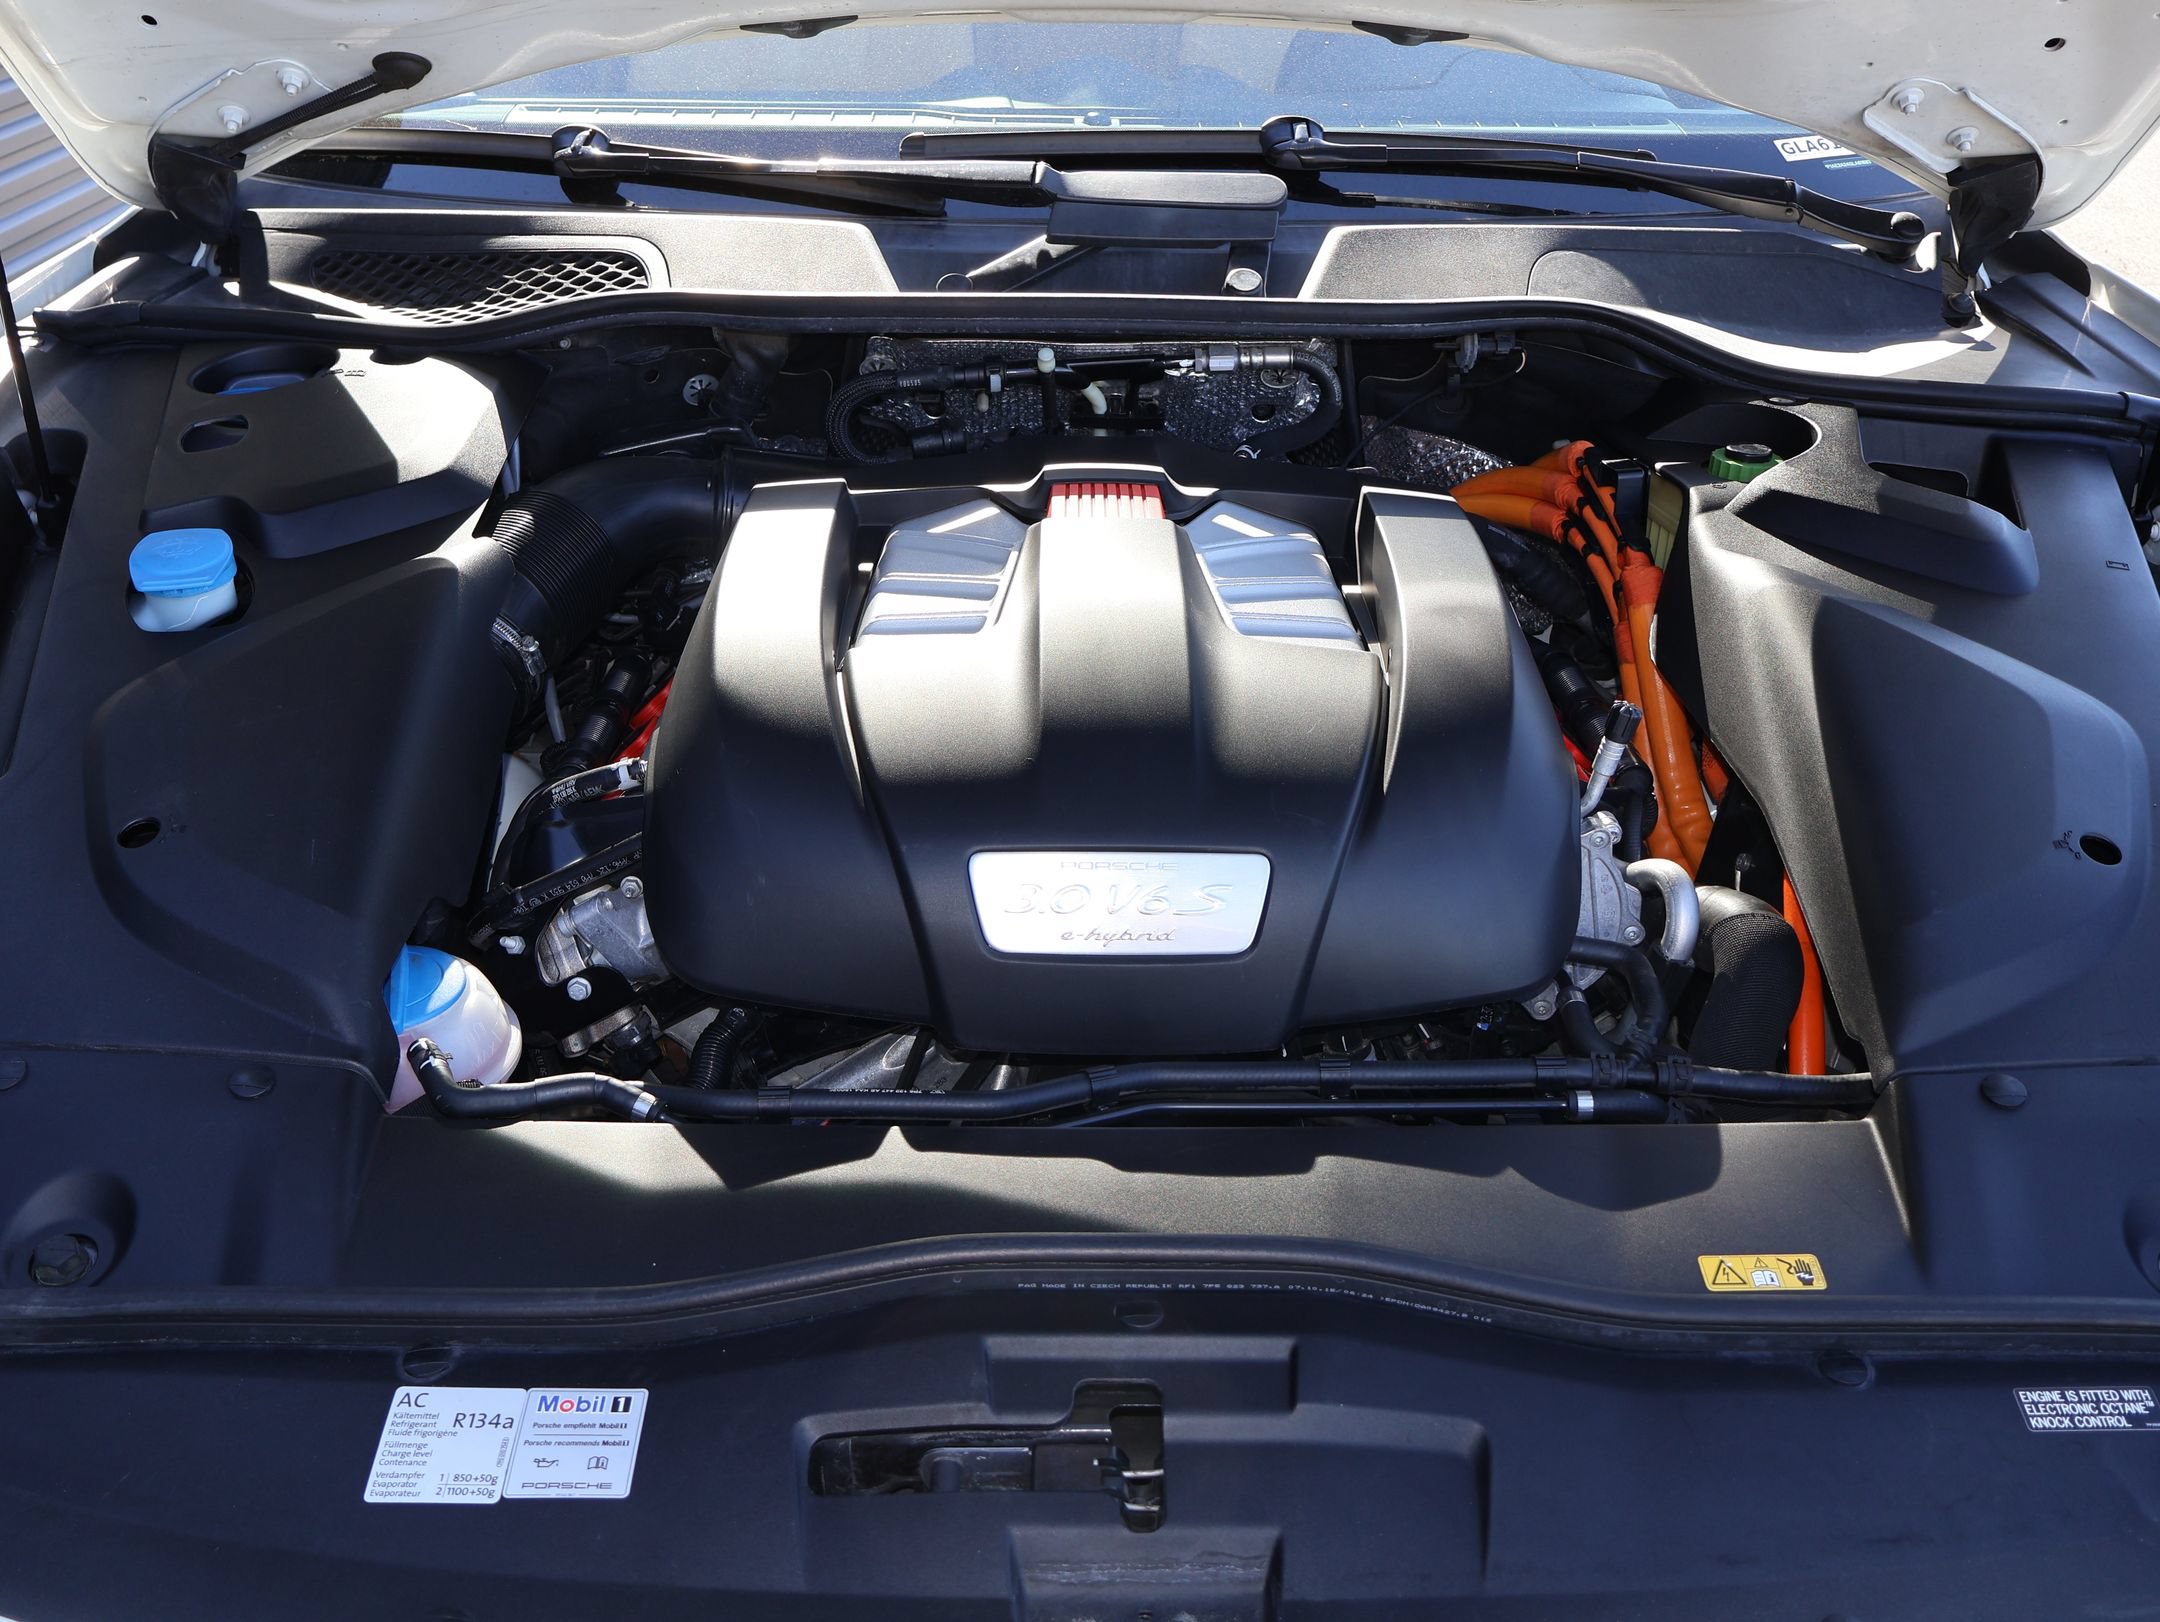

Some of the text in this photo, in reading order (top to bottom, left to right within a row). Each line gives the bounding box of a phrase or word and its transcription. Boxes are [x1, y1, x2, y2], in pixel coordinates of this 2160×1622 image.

[1060, 861, 1178, 871] PORSCHE
[1003, 884, 1233, 916] 3.0 V6 S
[1060, 928, 1176, 948] e-hybrid
[396, 1392, 430, 1408] AC
[2018, 1389, 2152, 1403] ENGINE IS FITTED WITH
[537, 1395, 606, 1413] Mobil
[2024, 1403, 2099, 1415] ELECTRONIC
[393, 1412, 440, 1420] Kältemittel
[452, 1412, 515, 1429] R134a
[390, 1420, 437, 1430] Refrigerant
[563, 1422, 597, 1430] empfiehlt
[2029, 1415, 2133, 1429] KNOCK CONTROL
[388, 1428, 413, 1436] Fluide
[384, 1440, 429, 1450] Füllmenge
[523, 1439, 553, 1447] Porsche
[381, 1449, 434, 1459] Charge level
[375, 1471, 426, 1481] Verdampfer
[452, 1473, 499, 1486] 850+50g
[372, 1480, 418, 1490] Evaporator
[521, 1481, 613, 1490] PORSCHE
[447, 1486, 496, 1499] 1100+50g
